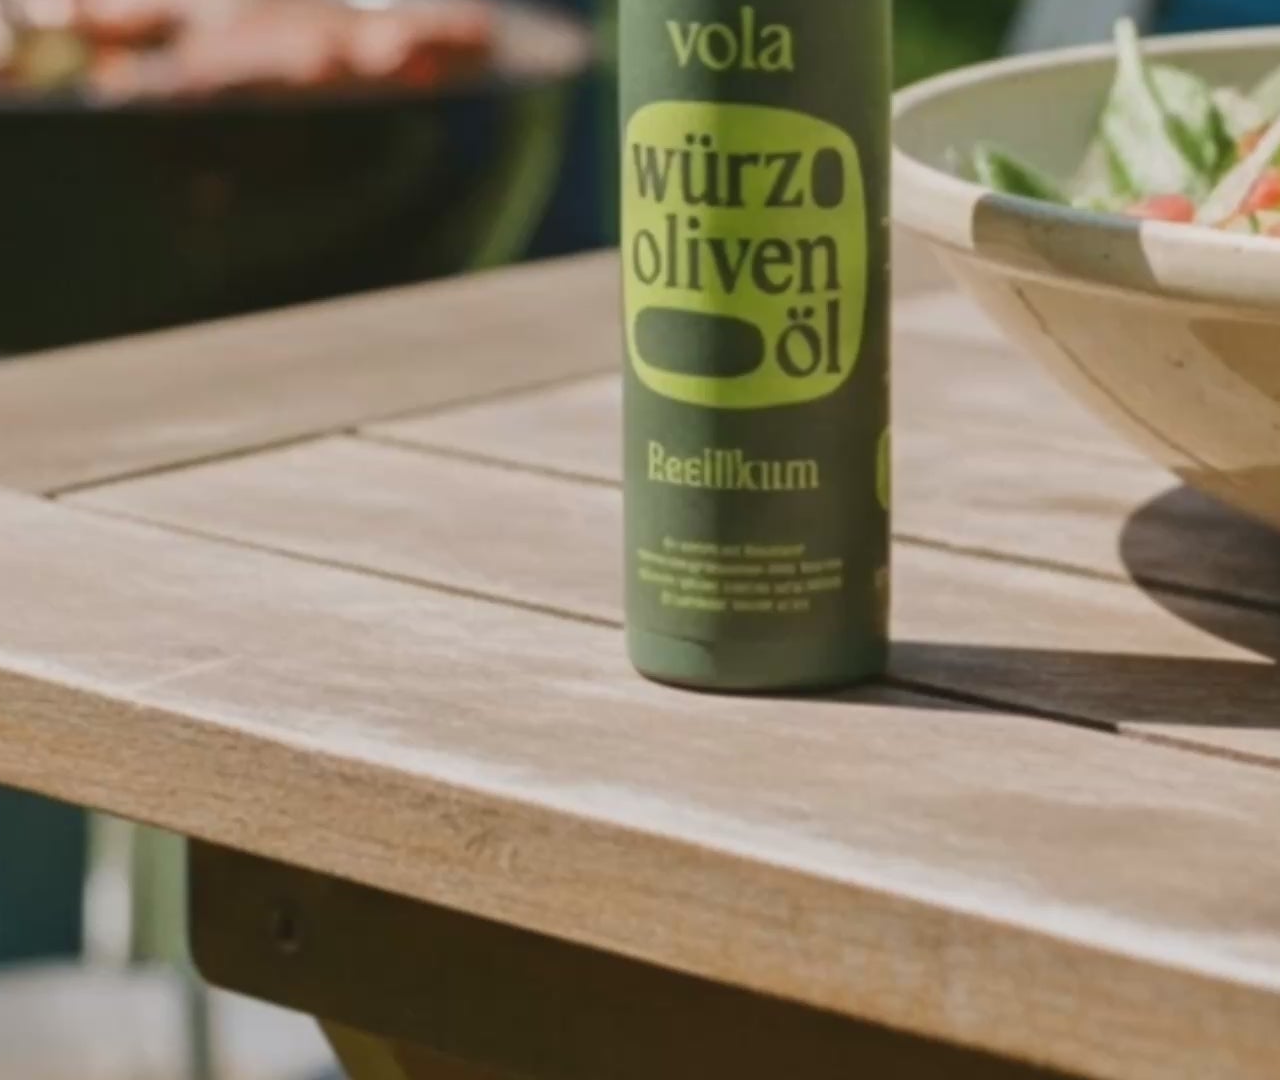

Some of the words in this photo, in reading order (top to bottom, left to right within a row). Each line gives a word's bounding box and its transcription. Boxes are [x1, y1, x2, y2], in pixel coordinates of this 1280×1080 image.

[666, 6, 794, 71] vola
[632, 213, 841, 295] oliven
[776, 298, 841, 378] öl
